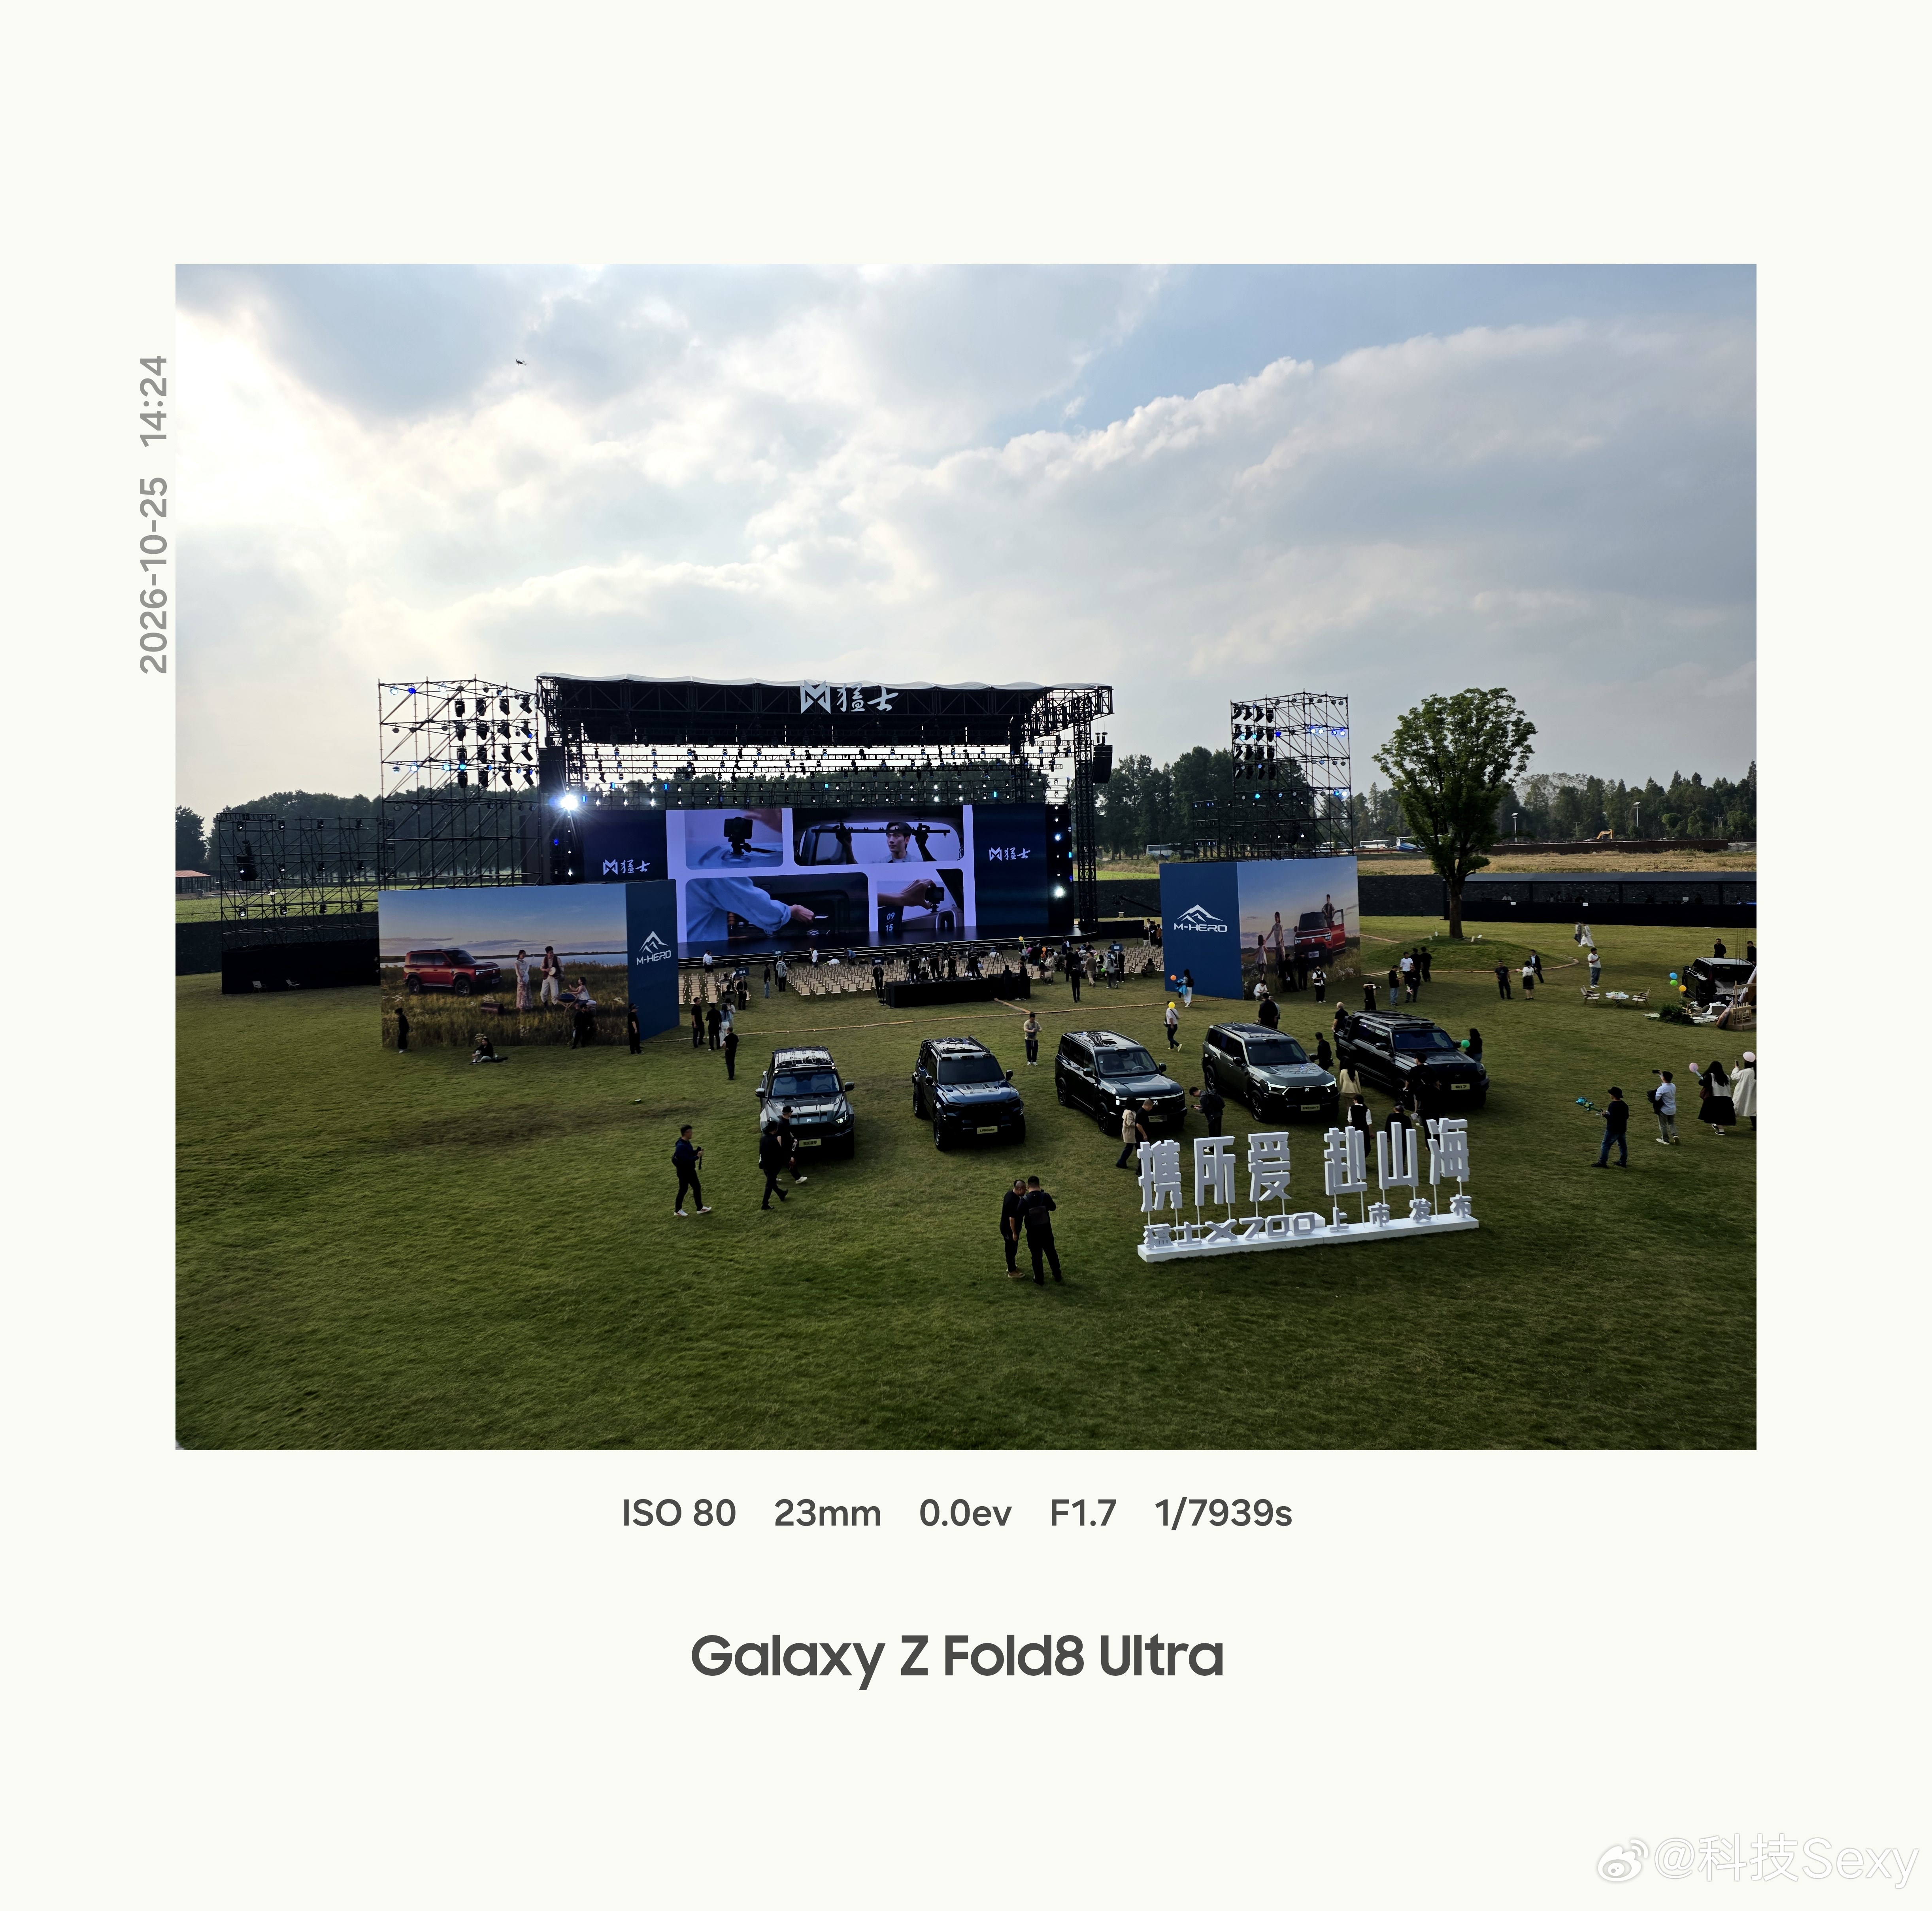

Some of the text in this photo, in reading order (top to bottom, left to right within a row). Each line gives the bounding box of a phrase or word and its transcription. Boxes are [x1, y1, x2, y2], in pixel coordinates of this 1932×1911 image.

[836, 683, 899, 712] 猛士
[1004, 847, 1031, 860] 猛士
[620, 859, 651, 874] 猛士
[1174, 923, 1228, 933] M-HERO
[636, 950, 671, 965] M-HERO
[1137, 1118, 1469, 1212] 携所爱 赴山海
